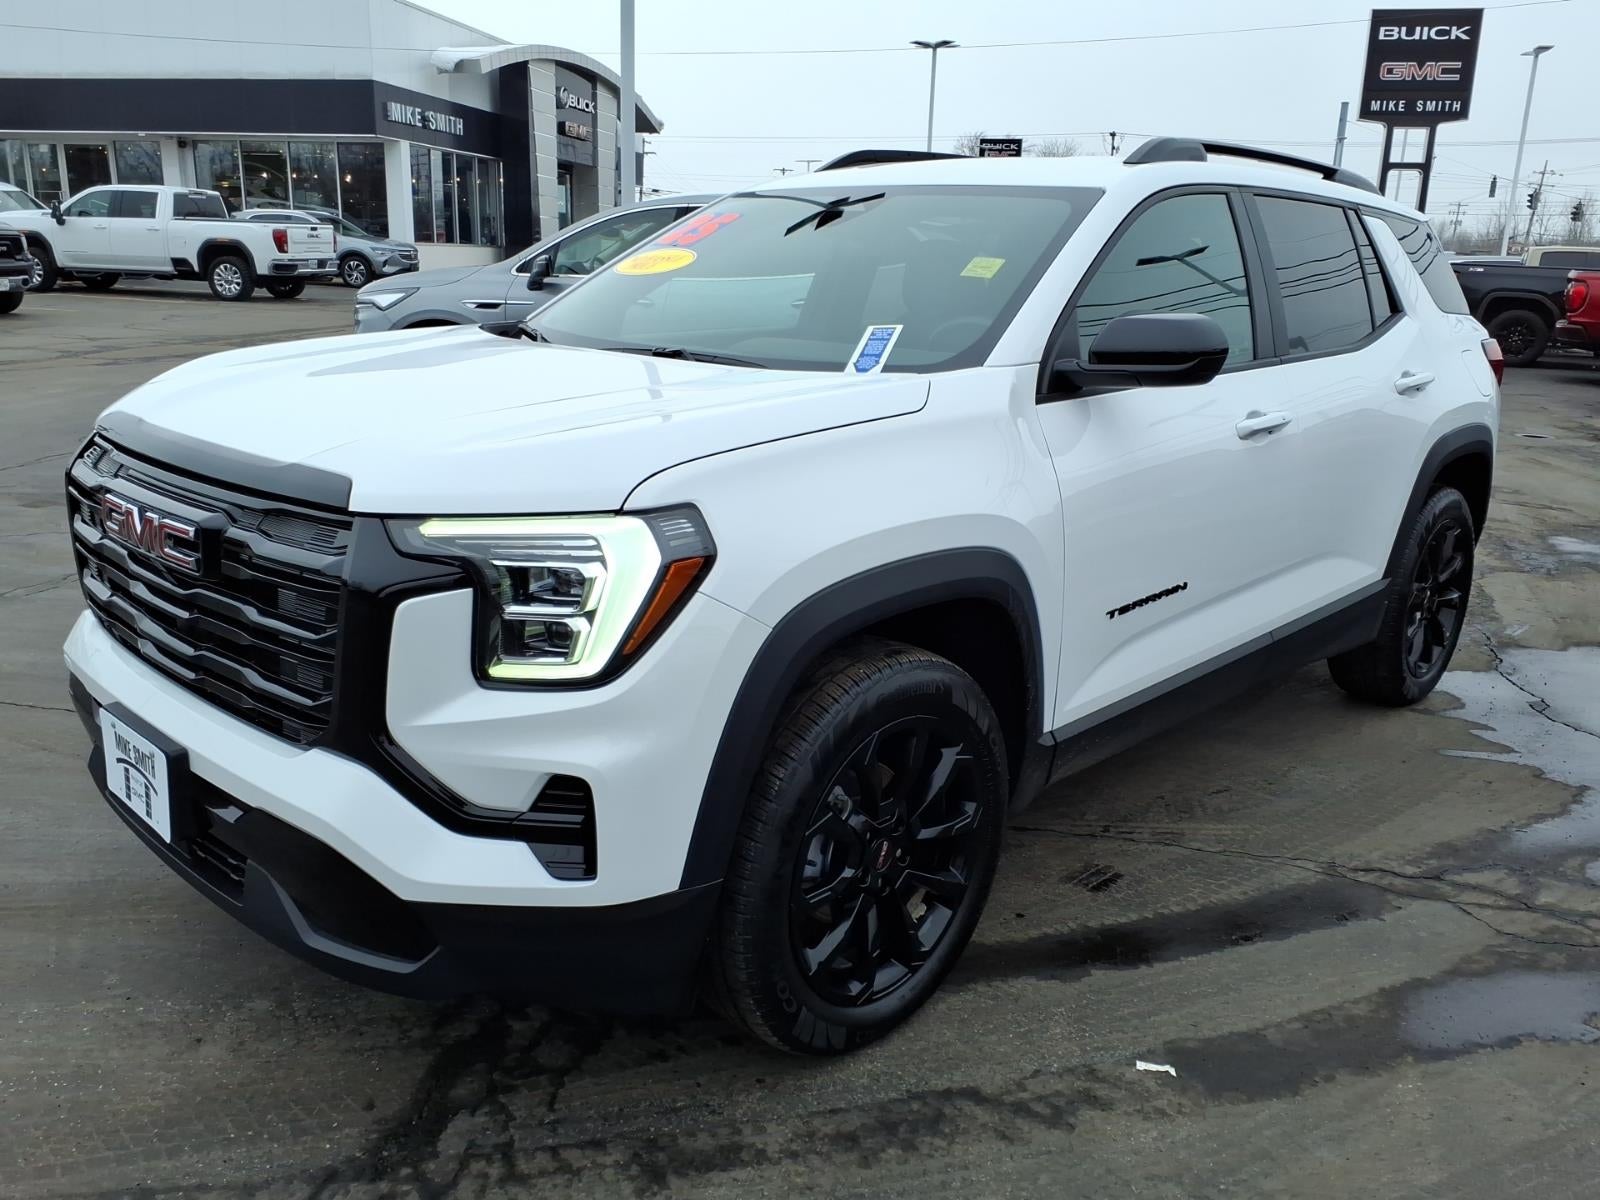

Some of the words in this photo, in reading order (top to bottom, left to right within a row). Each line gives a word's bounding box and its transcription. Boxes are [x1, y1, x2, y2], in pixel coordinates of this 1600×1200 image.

[1378, 26, 1471, 40] BUICK
[1379, 62, 1462, 80] GMC
[569, 94, 595, 114] BUICK
[1371, 100, 1406, 112] MIKE
[1416, 100, 1462, 112] SMITH
[389, 101, 423, 127] MIKE
[427, 110, 464, 136] SMITH
[101, 492, 201, 571] GMC
[1105, 581, 1188, 620] TERRAIN
[114, 730, 132, 760] MIKE
[133, 745, 156, 780] SMITH
